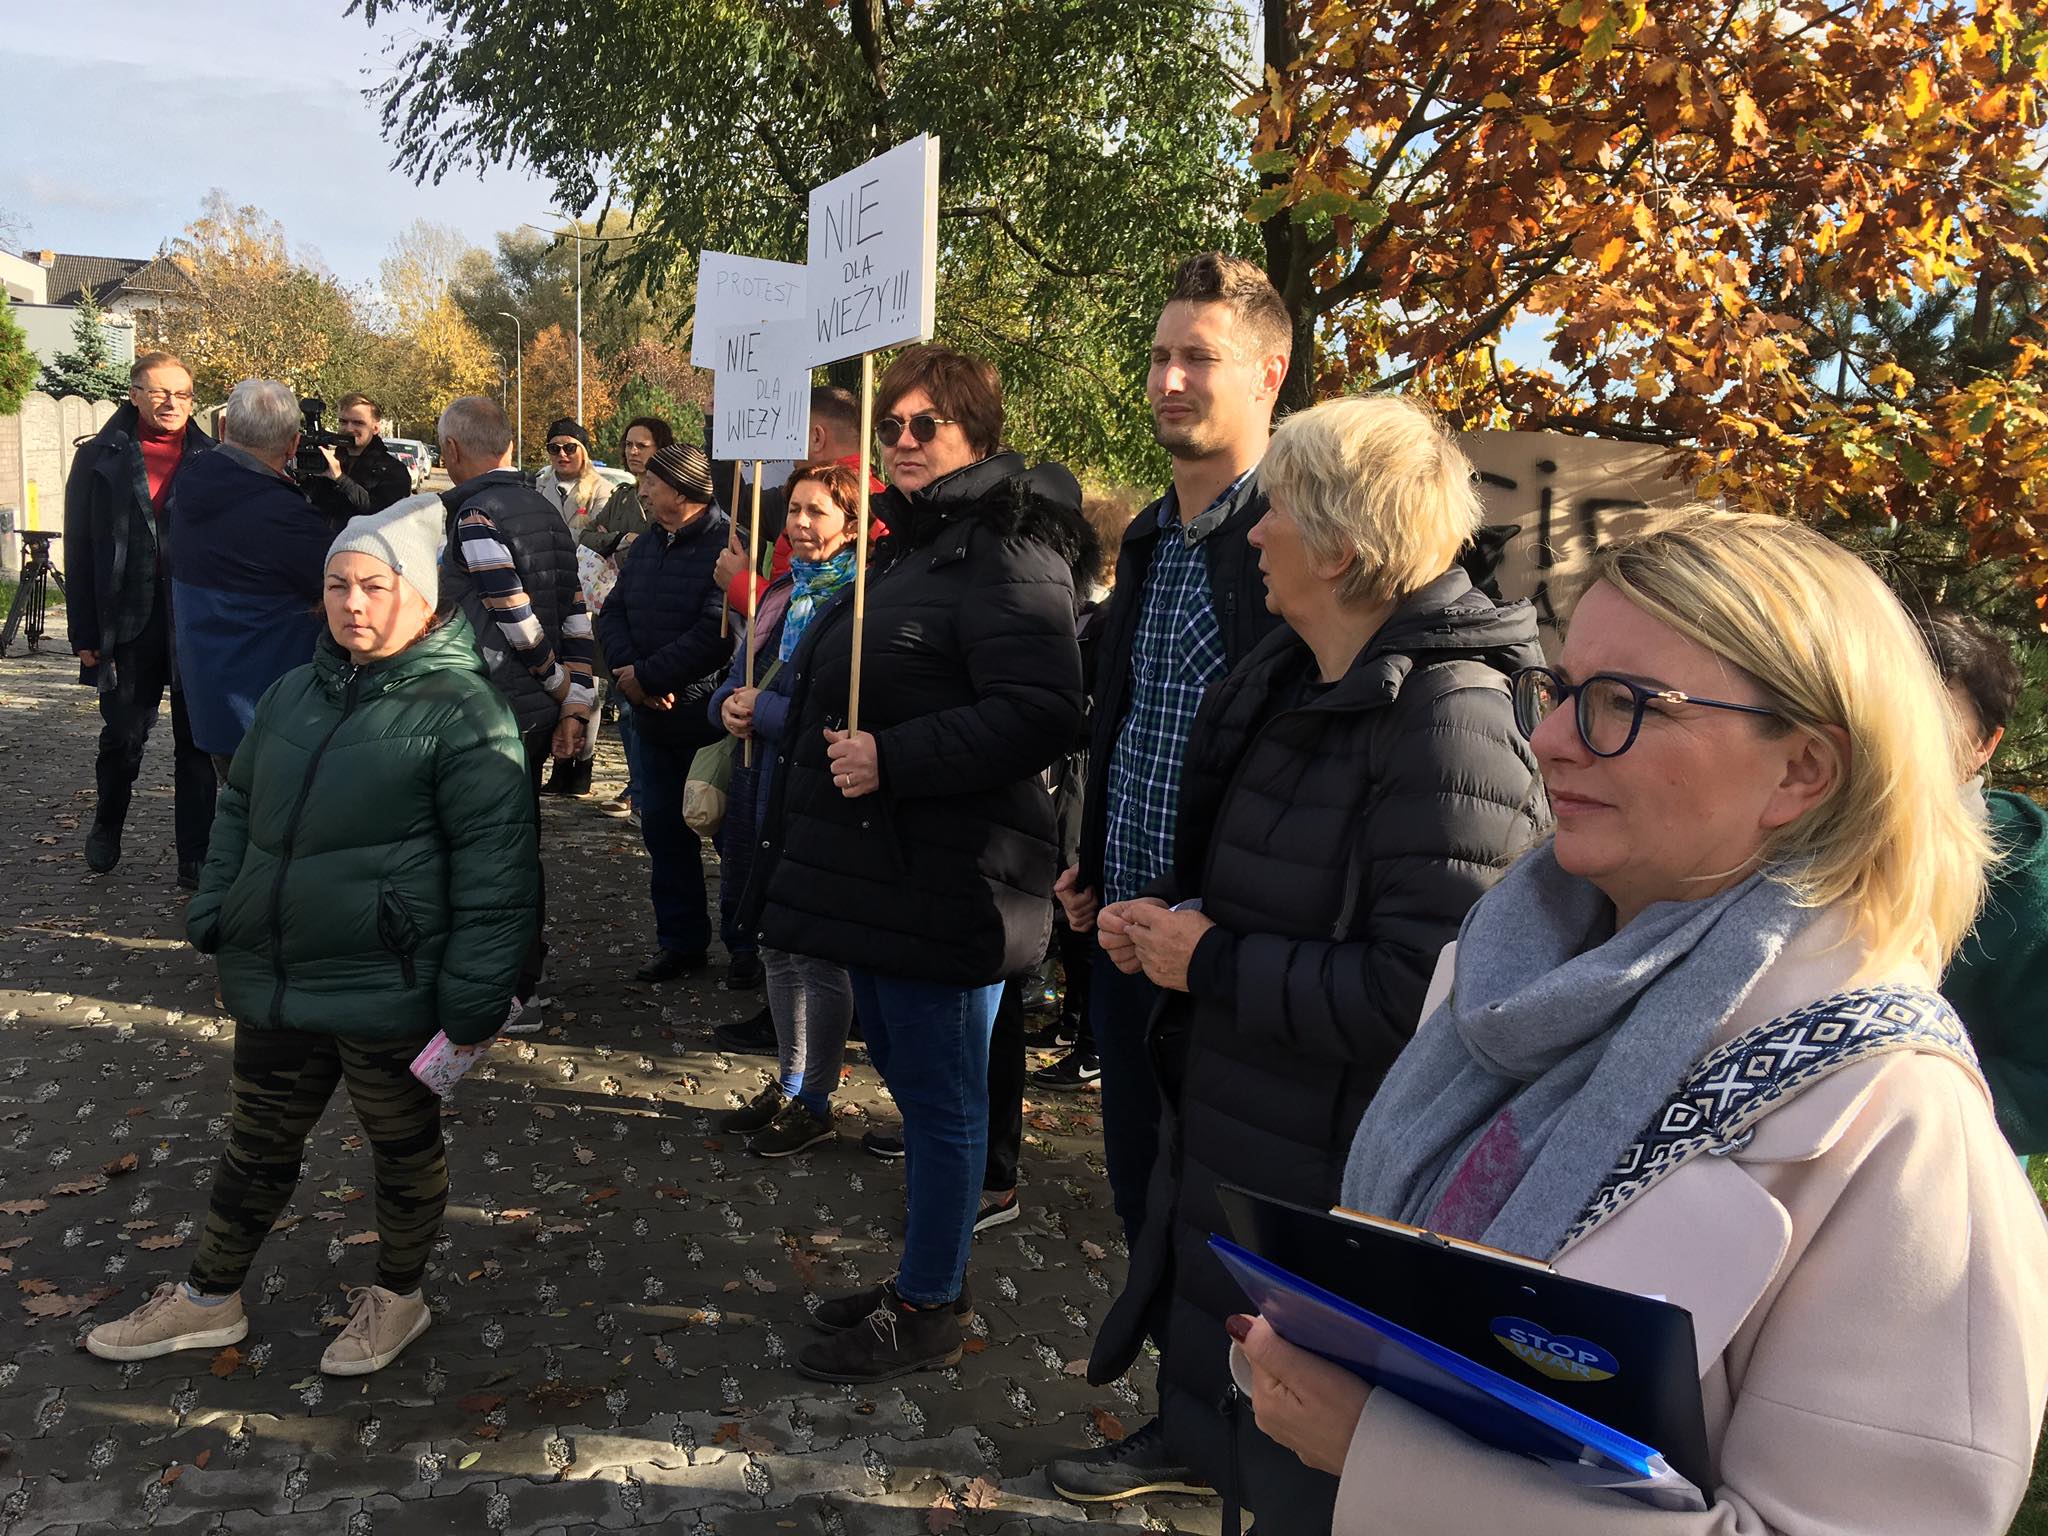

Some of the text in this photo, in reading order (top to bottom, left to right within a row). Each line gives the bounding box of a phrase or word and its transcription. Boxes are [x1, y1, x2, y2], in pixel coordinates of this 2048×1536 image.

[825, 178, 883, 259] NIE
[843, 255, 874, 284] DLA
[716, 270, 801, 308] PROTEST
[726, 332, 761, 373] NIE
[756, 377, 780, 401] DLA
[1509, 1327, 1599, 1364] STOP
[1513, 1341, 1591, 1378] WAR
